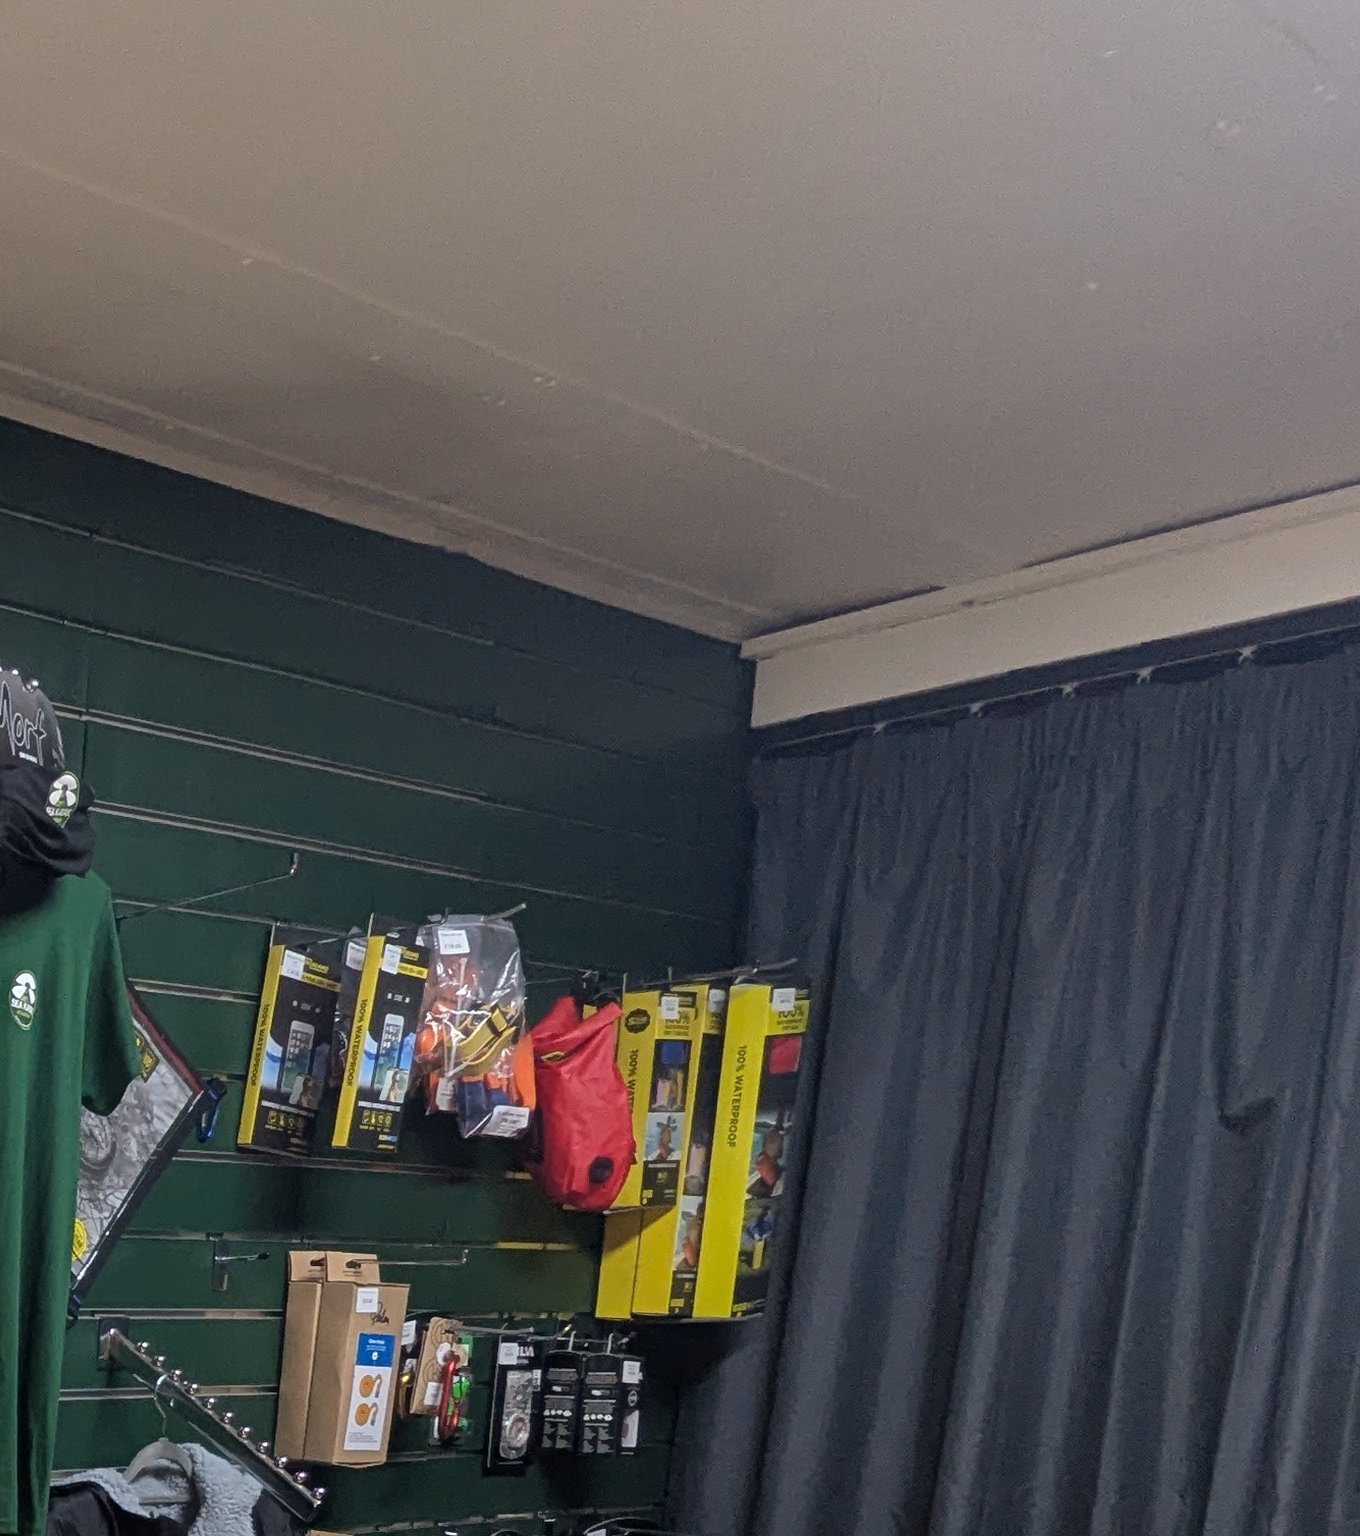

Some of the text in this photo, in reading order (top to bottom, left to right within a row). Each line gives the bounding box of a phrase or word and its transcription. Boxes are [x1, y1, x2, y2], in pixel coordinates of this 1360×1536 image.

[628, 1049, 639, 1075] 100%
[728, 1046, 747, 1148] 100% WATERPROOF
